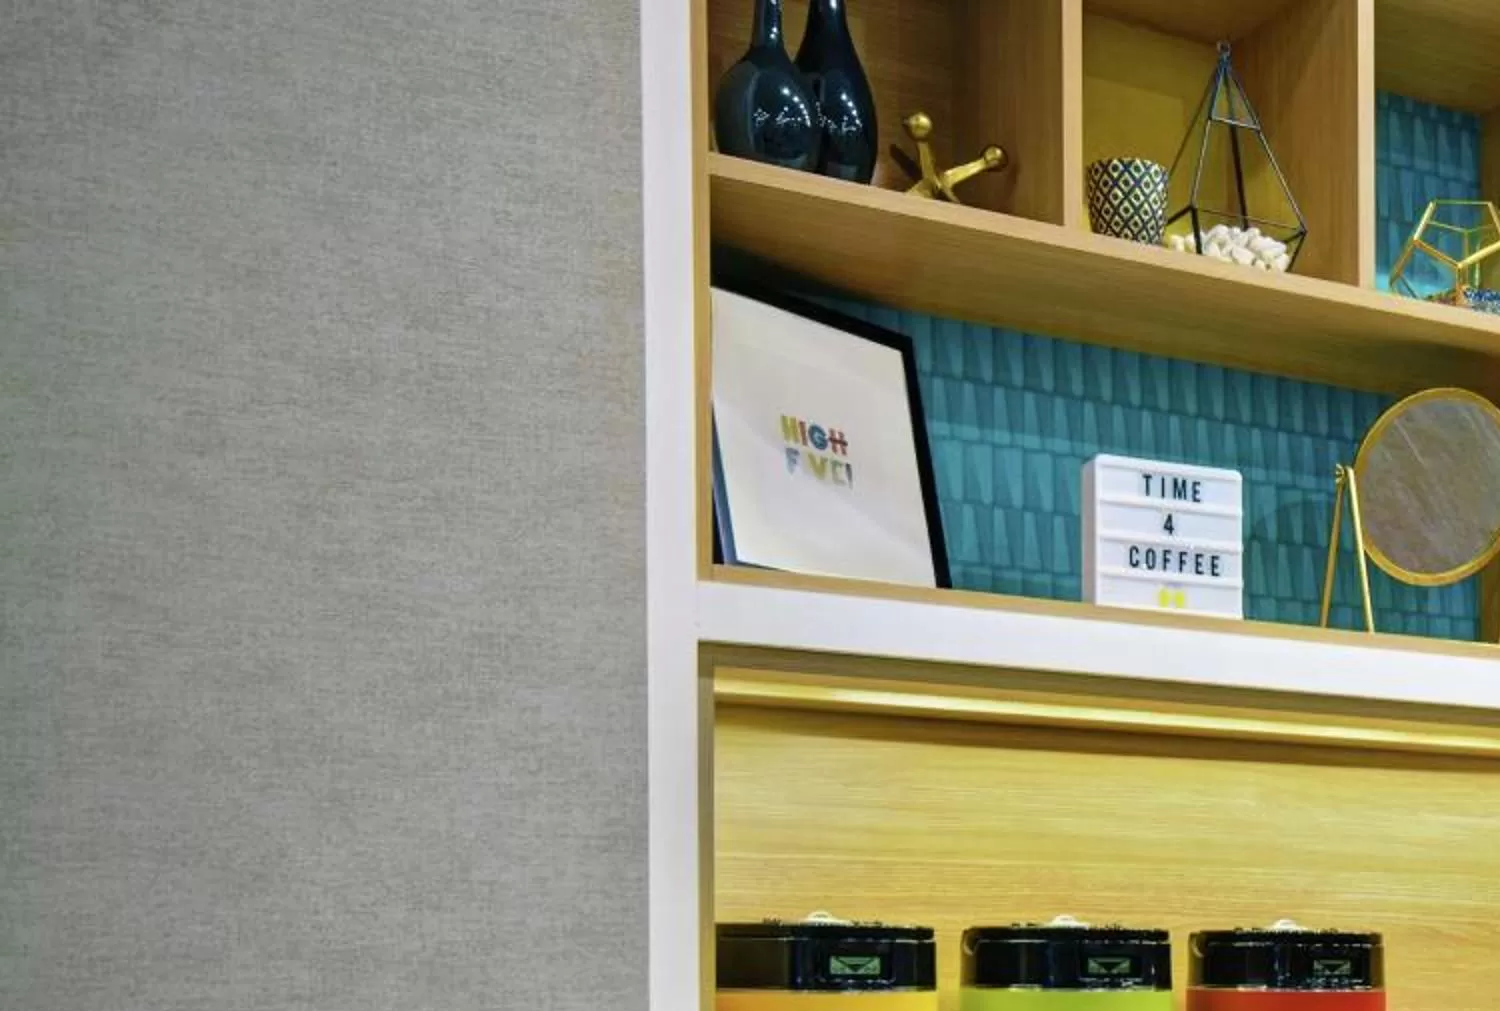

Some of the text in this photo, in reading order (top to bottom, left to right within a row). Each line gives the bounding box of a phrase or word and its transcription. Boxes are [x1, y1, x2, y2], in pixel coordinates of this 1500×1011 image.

[780, 414, 848, 457] HIGH
[785, 447, 854, 490] FVE!
[1142, 474, 1202, 503] TIME
[1163, 513, 1175, 535] 4
[1129, 545, 1221, 577] COFFEE
